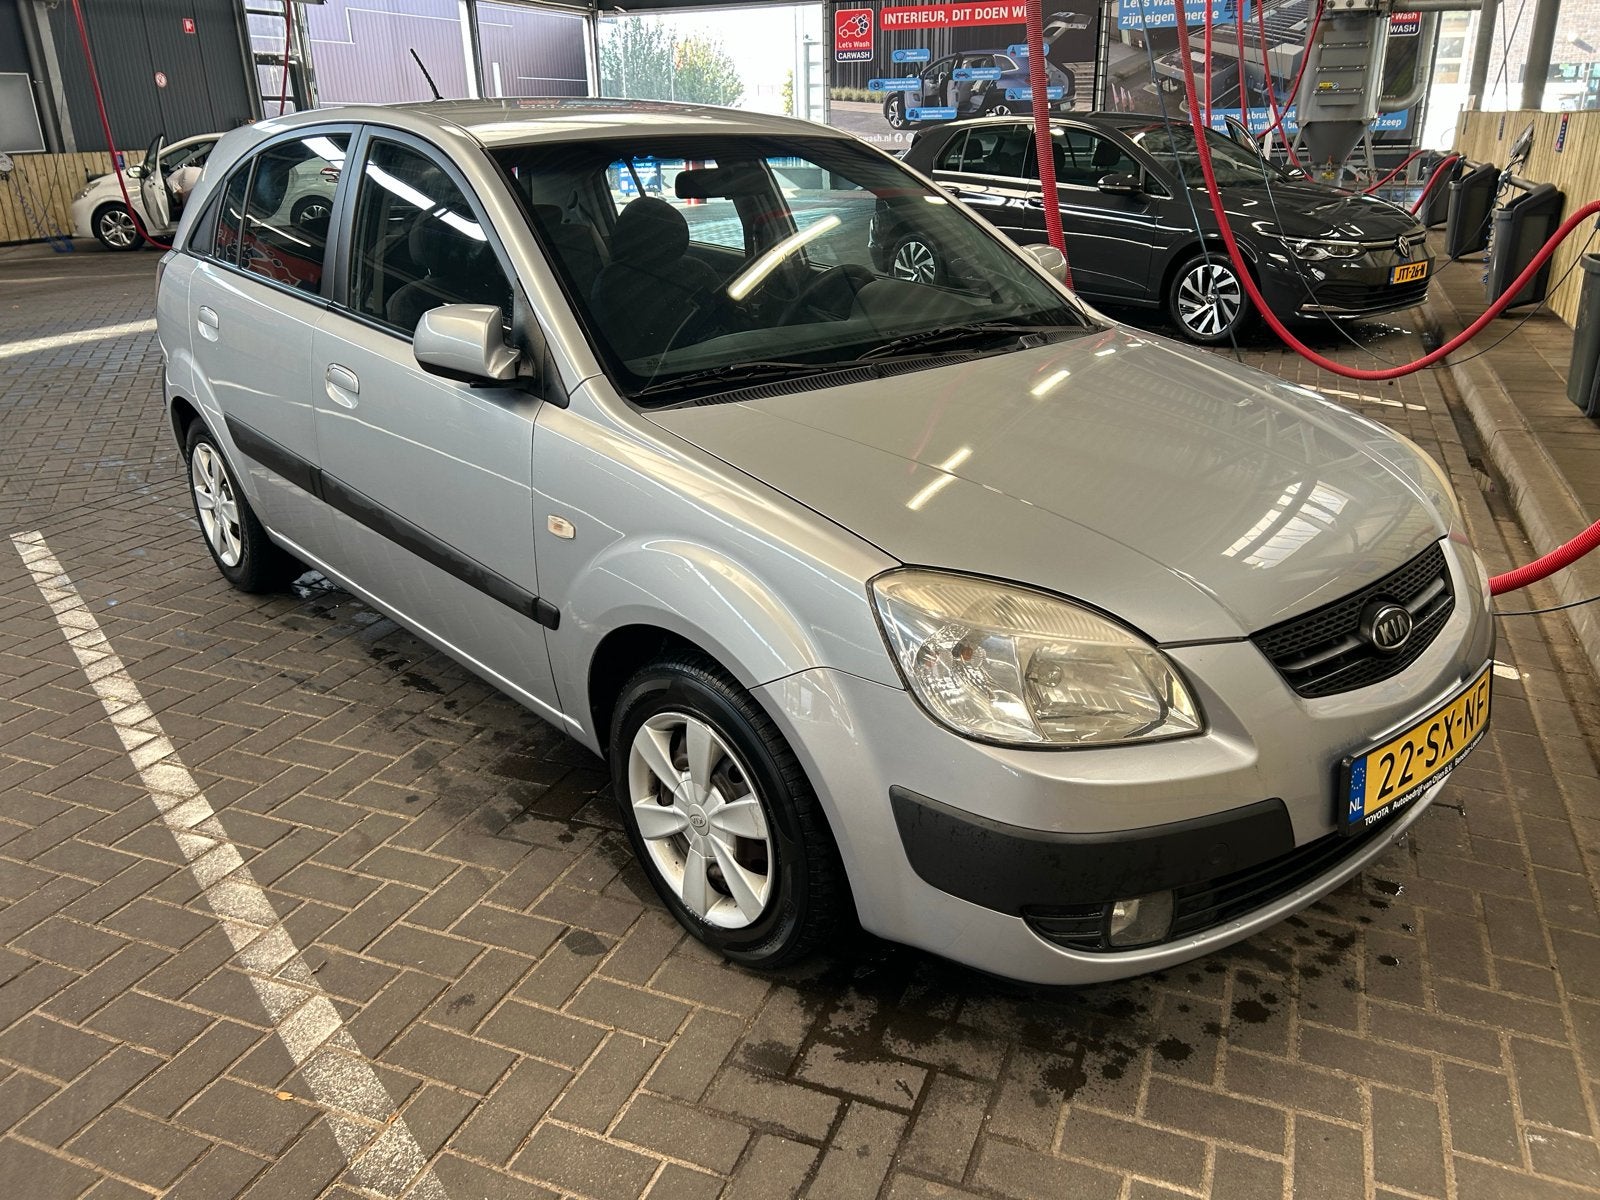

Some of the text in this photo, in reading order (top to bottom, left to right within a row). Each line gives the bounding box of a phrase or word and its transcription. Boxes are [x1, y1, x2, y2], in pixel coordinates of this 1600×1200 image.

[884, 5, 1027, 25] INTERIEUR, DIT DOEN WI
[1122, 10, 1219, 26] zijn eigen nerge
[838, 51, 870, 60] CARWASH
[1381, 119, 1402, 128] zeep
[1378, 614, 1409, 645] KIA
[1377, 680, 1486, 801] 22-SX-NF
[1349, 797, 1363, 814] NL
[1364, 806, 1390, 826] TOYOTA
[1392, 785, 1424, 810] Autobedrijf
